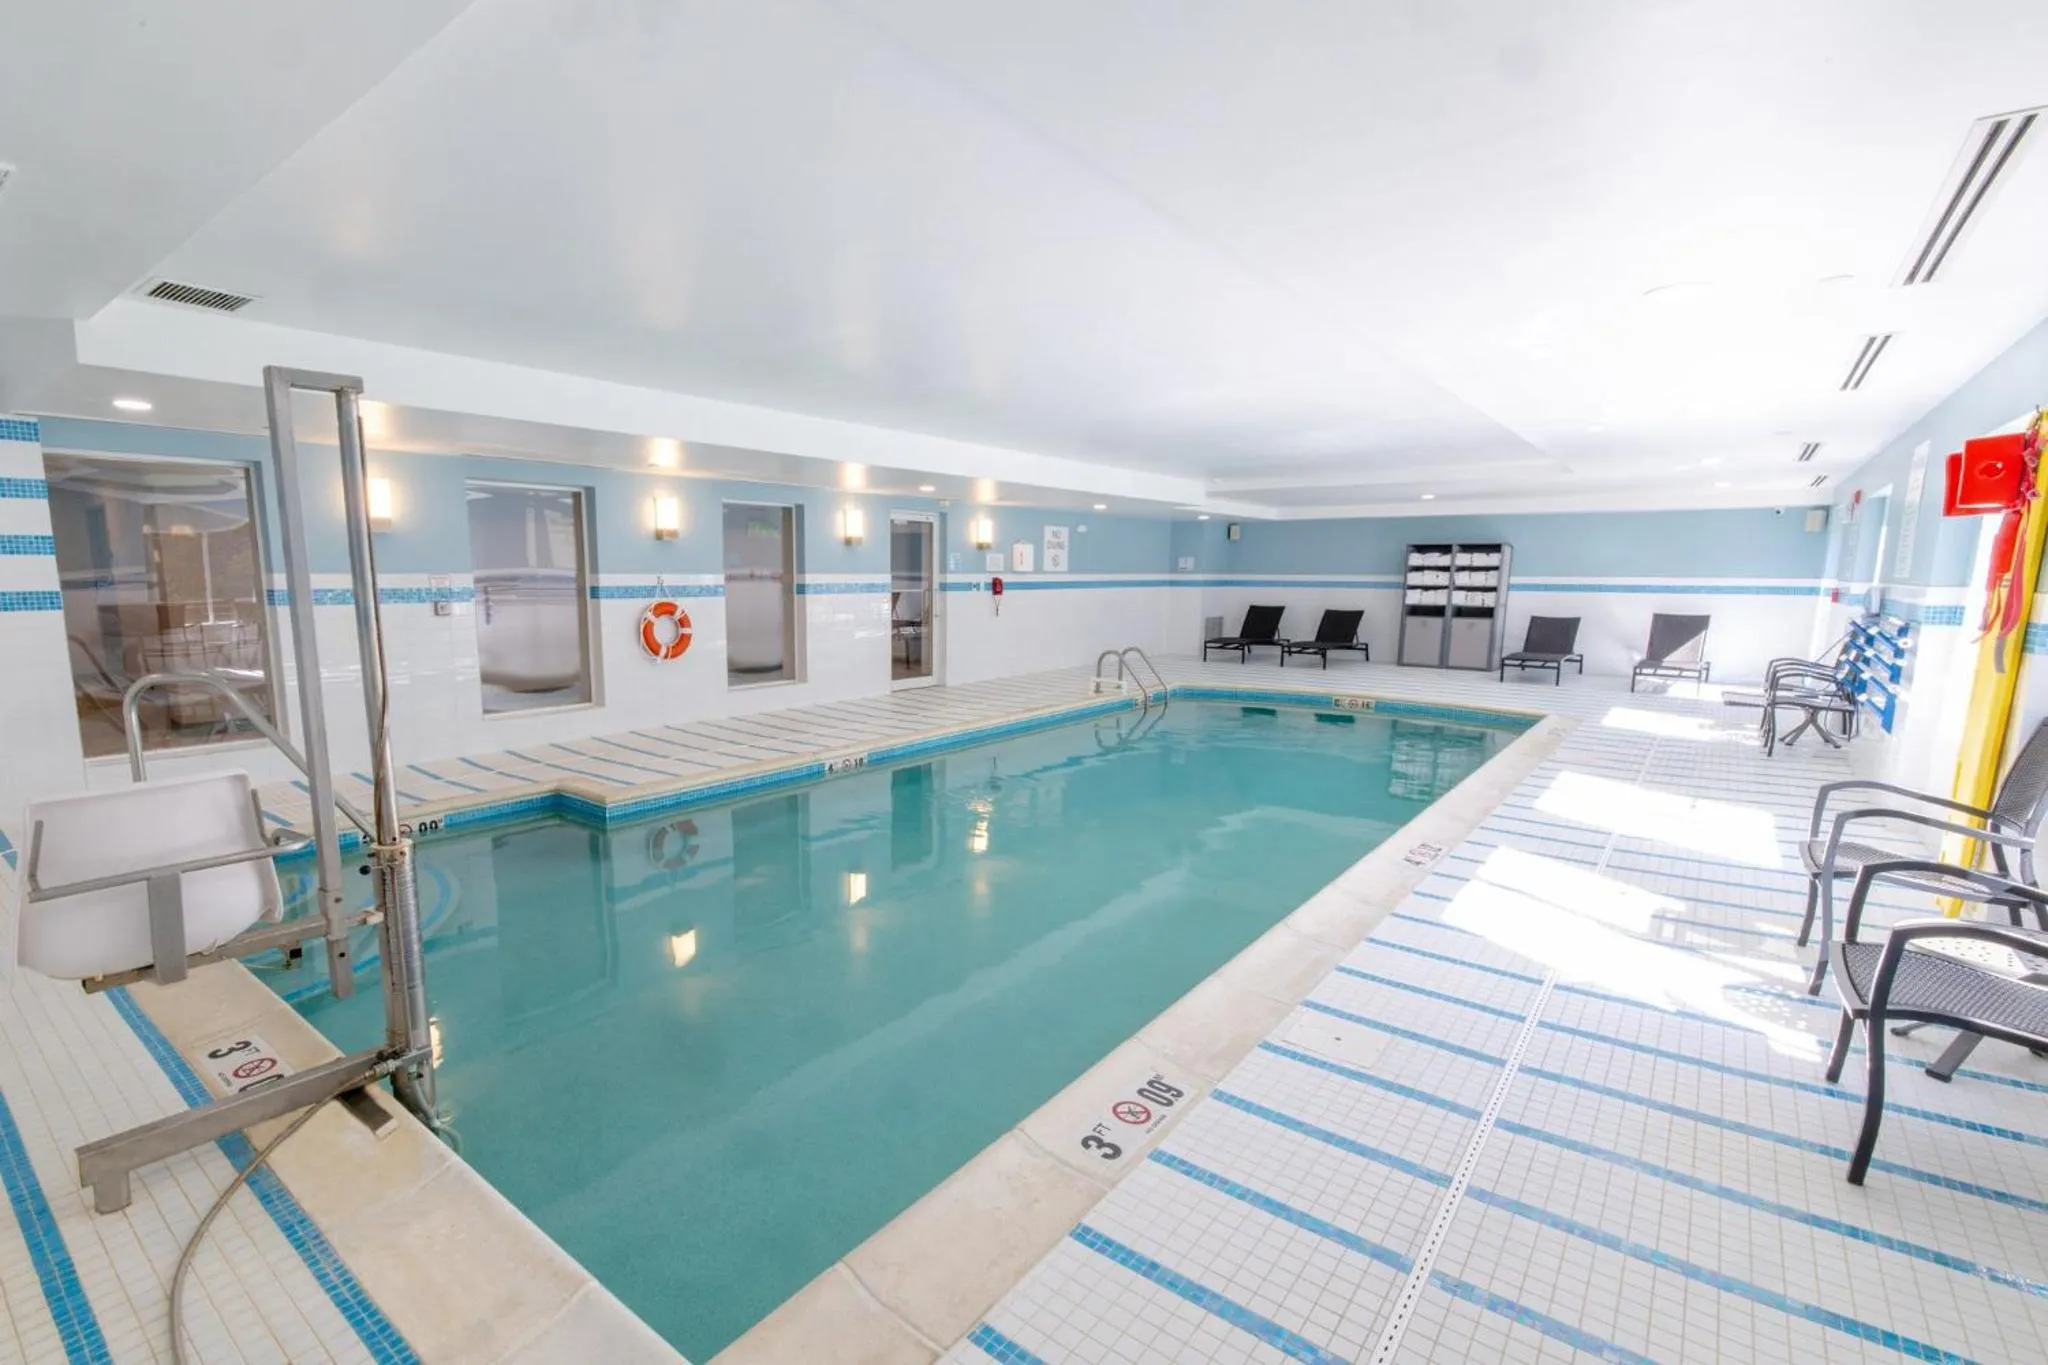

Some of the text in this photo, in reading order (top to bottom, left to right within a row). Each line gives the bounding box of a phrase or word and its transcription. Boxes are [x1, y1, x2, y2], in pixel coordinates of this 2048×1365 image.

[207, 1039, 252, 1059] 3
[1081, 1134, 1123, 1161] 3
[1136, 1079, 1185, 1108] 09
